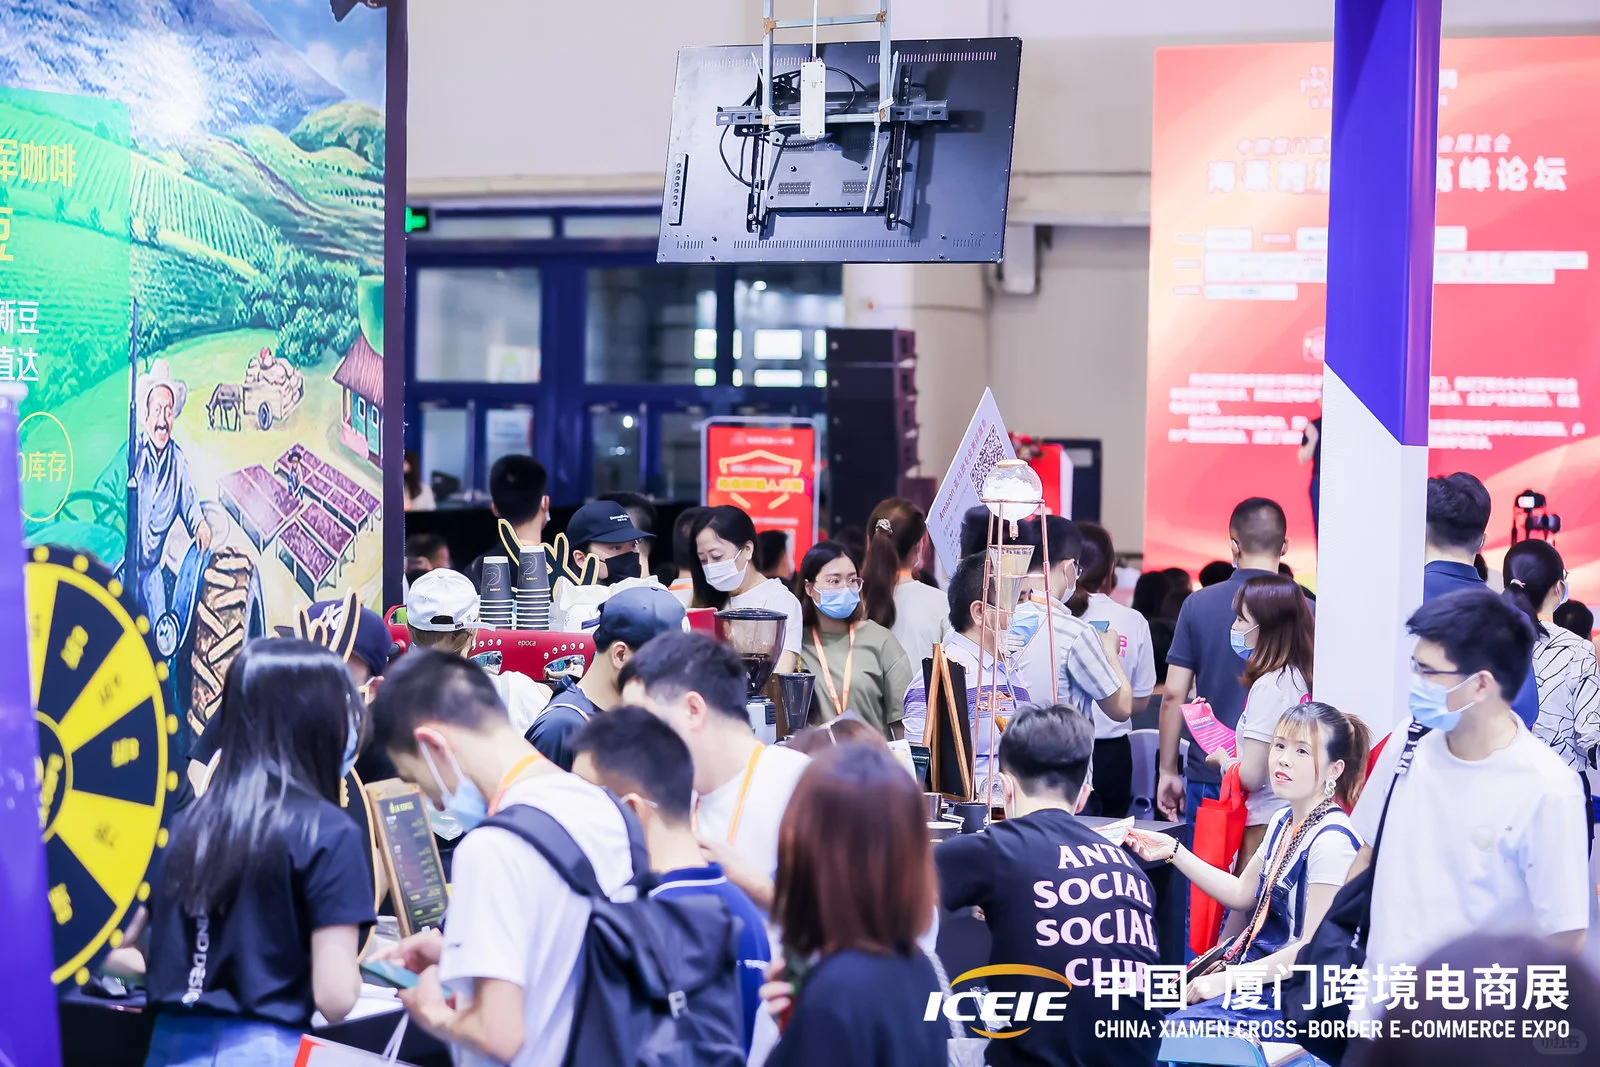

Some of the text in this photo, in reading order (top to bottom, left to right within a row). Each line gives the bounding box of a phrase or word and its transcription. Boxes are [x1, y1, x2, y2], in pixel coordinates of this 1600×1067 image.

[939, 488, 956, 521] Amazon
[1058, 843, 1132, 869] ANTI
[1033, 871, 1152, 909] SOCIAL
[1036, 909, 1157, 952] SOCIAL
